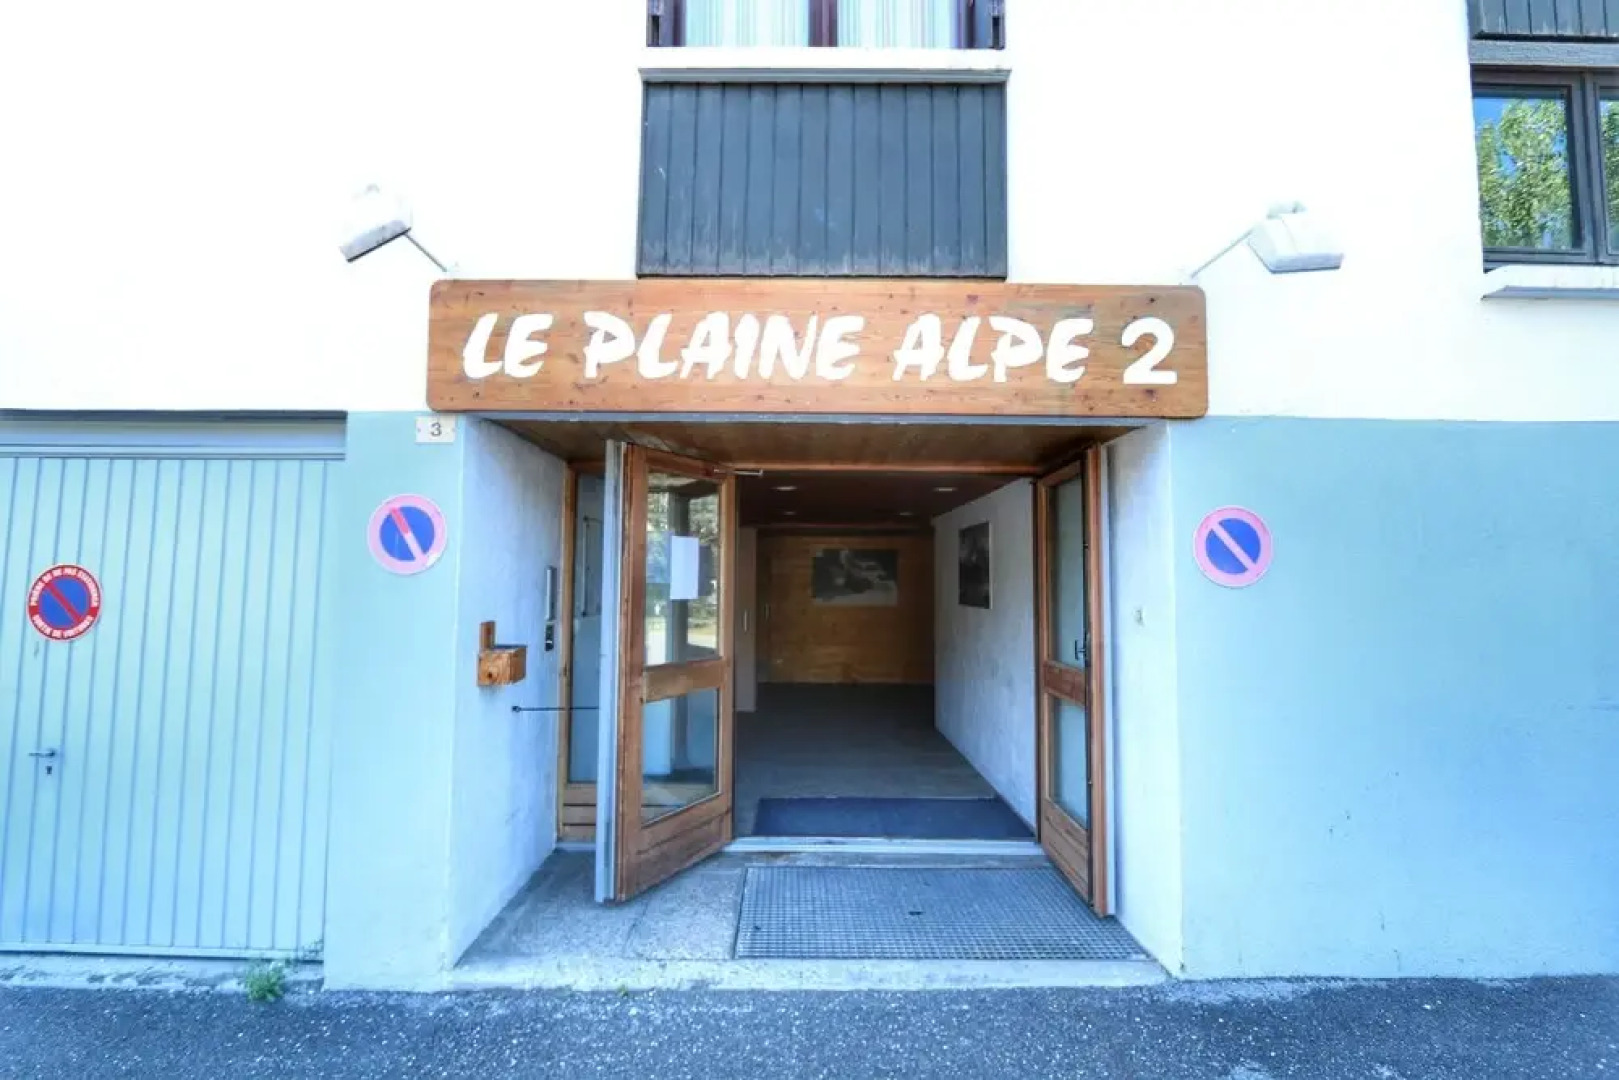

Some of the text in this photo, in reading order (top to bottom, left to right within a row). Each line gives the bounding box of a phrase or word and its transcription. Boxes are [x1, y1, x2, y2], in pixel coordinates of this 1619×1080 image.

[462, 311, 1178, 385] LE PLAINE ALPE 2
[431, 423, 442, 437] 3
